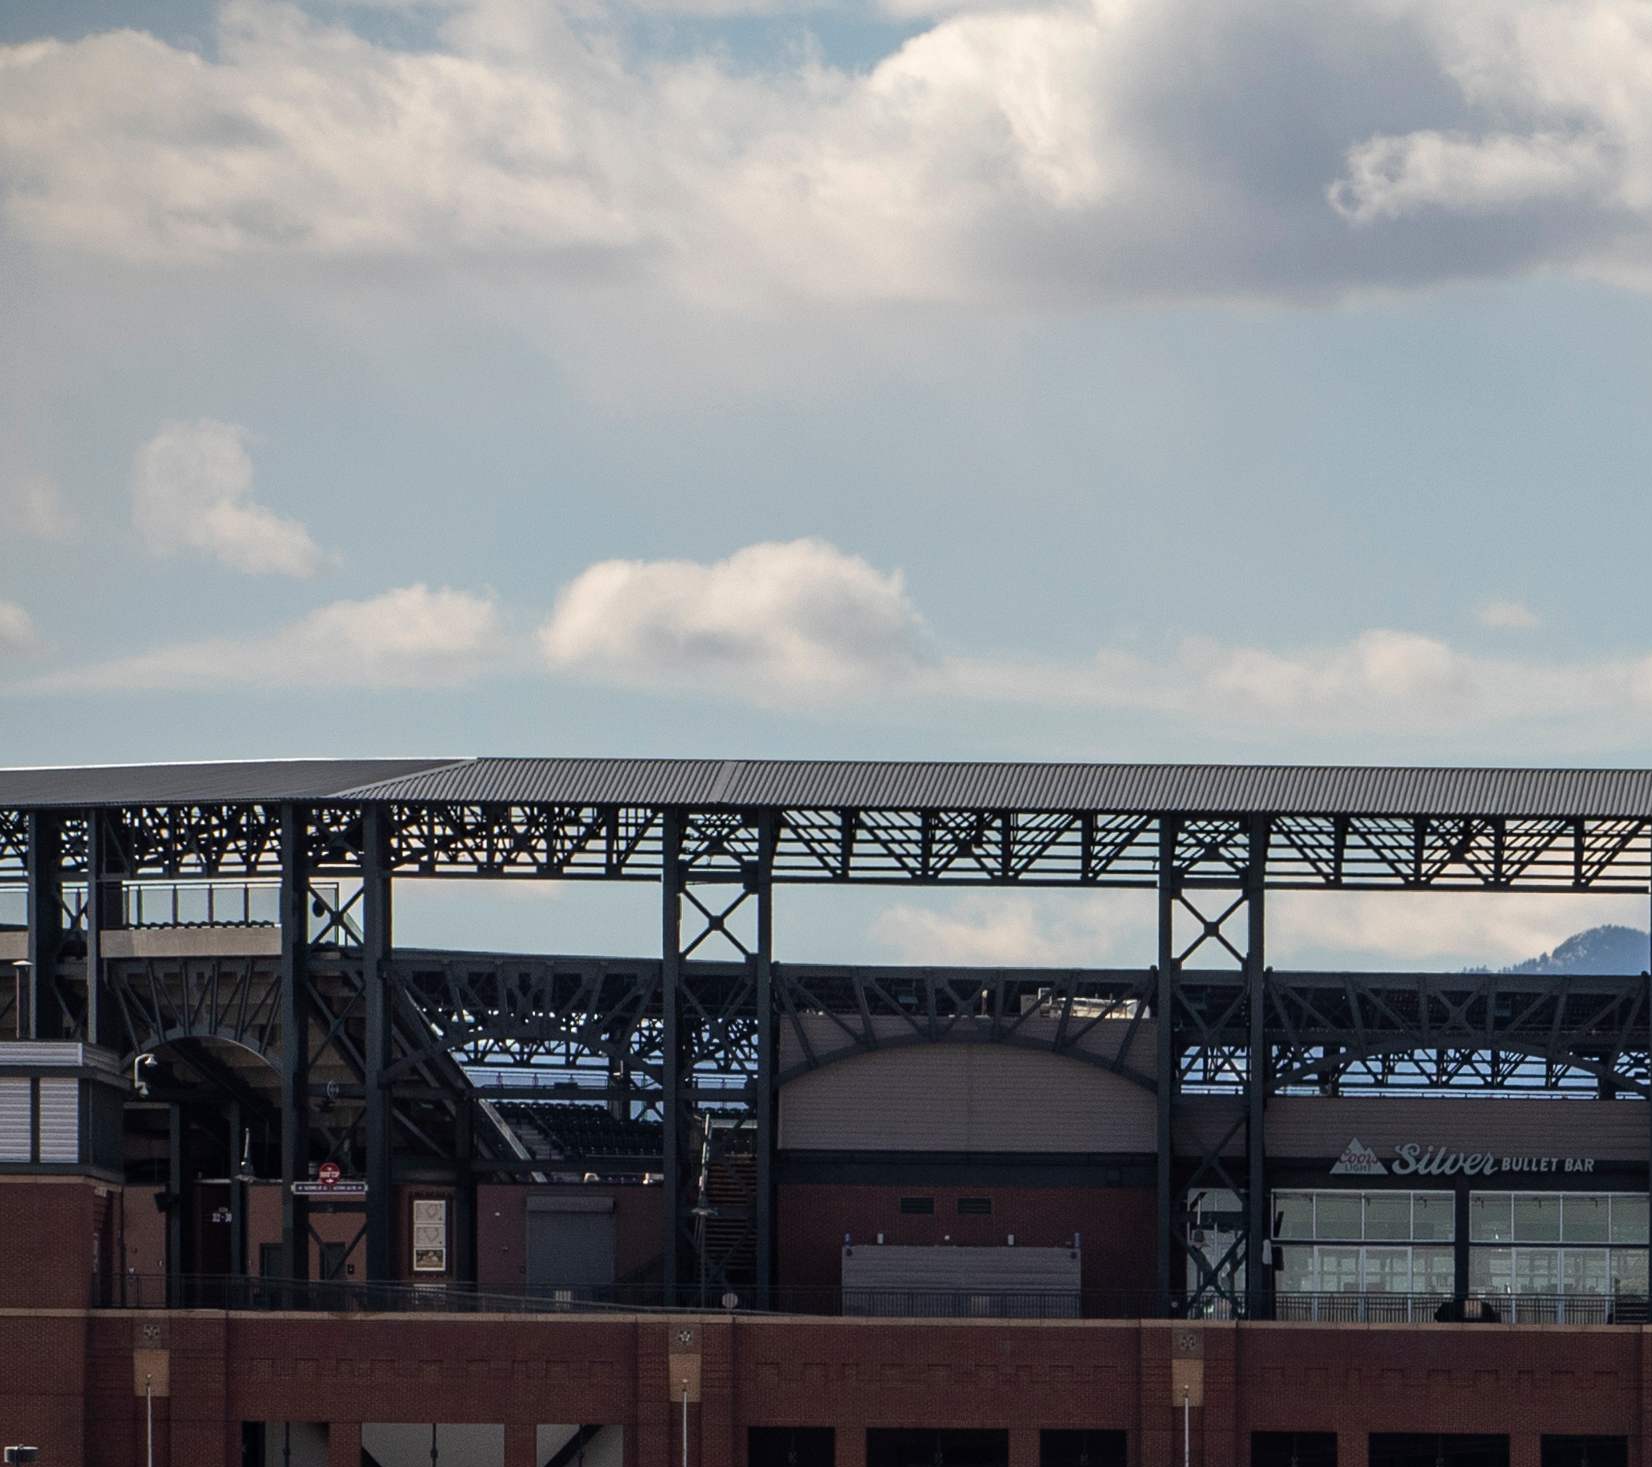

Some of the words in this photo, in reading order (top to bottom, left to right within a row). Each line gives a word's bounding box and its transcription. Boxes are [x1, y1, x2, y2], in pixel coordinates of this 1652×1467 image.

[1391, 1142, 1499, 1176] Silver
[1501, 1156, 1558, 1172] BULLET
[1564, 1157, 1596, 1173] BAR
